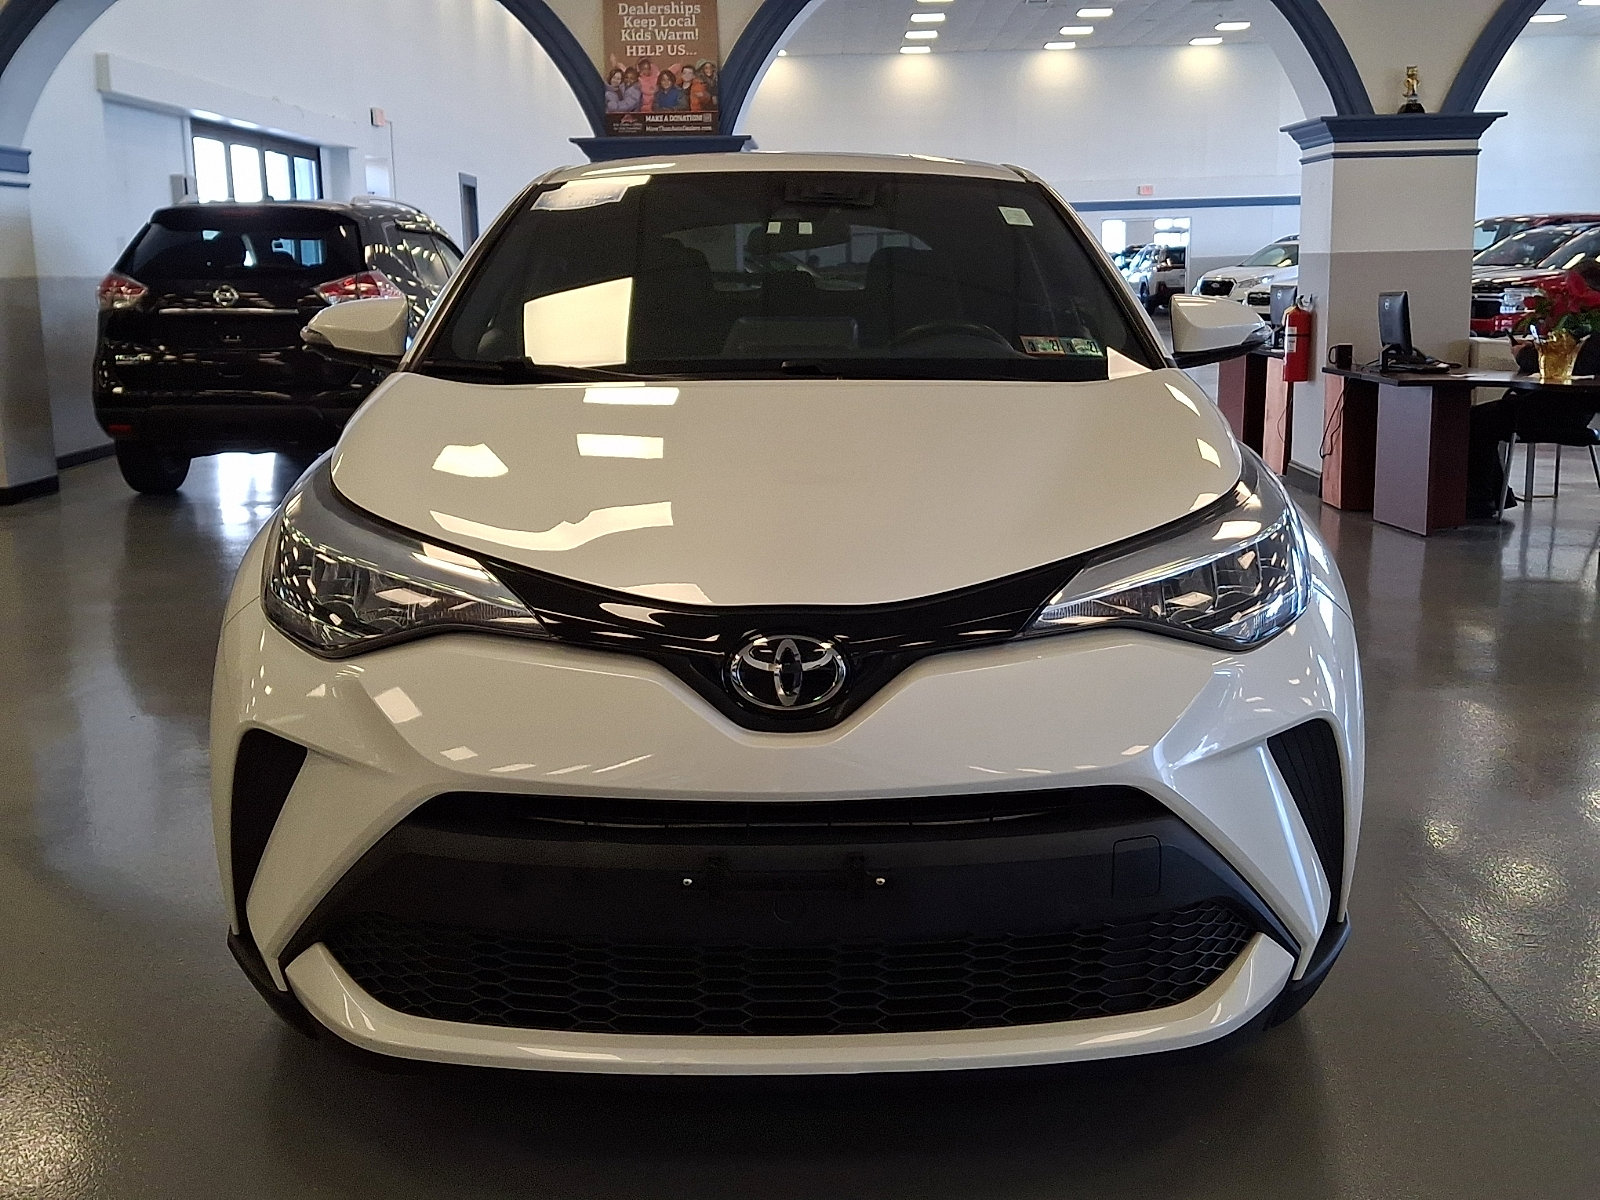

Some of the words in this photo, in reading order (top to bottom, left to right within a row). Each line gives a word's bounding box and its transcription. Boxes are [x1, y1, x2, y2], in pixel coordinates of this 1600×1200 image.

[618, 2, 701, 17] Dealerships
[623, 16, 657, 30] Keep
[660, 14, 697, 27] Local
[621, 28, 651, 41] Kids
[654, 28, 699, 41] Warm!
[626, 45, 664, 57] HELP
[667, 44, 697, 56] US...
[645, 114, 664, 122] MAKE
